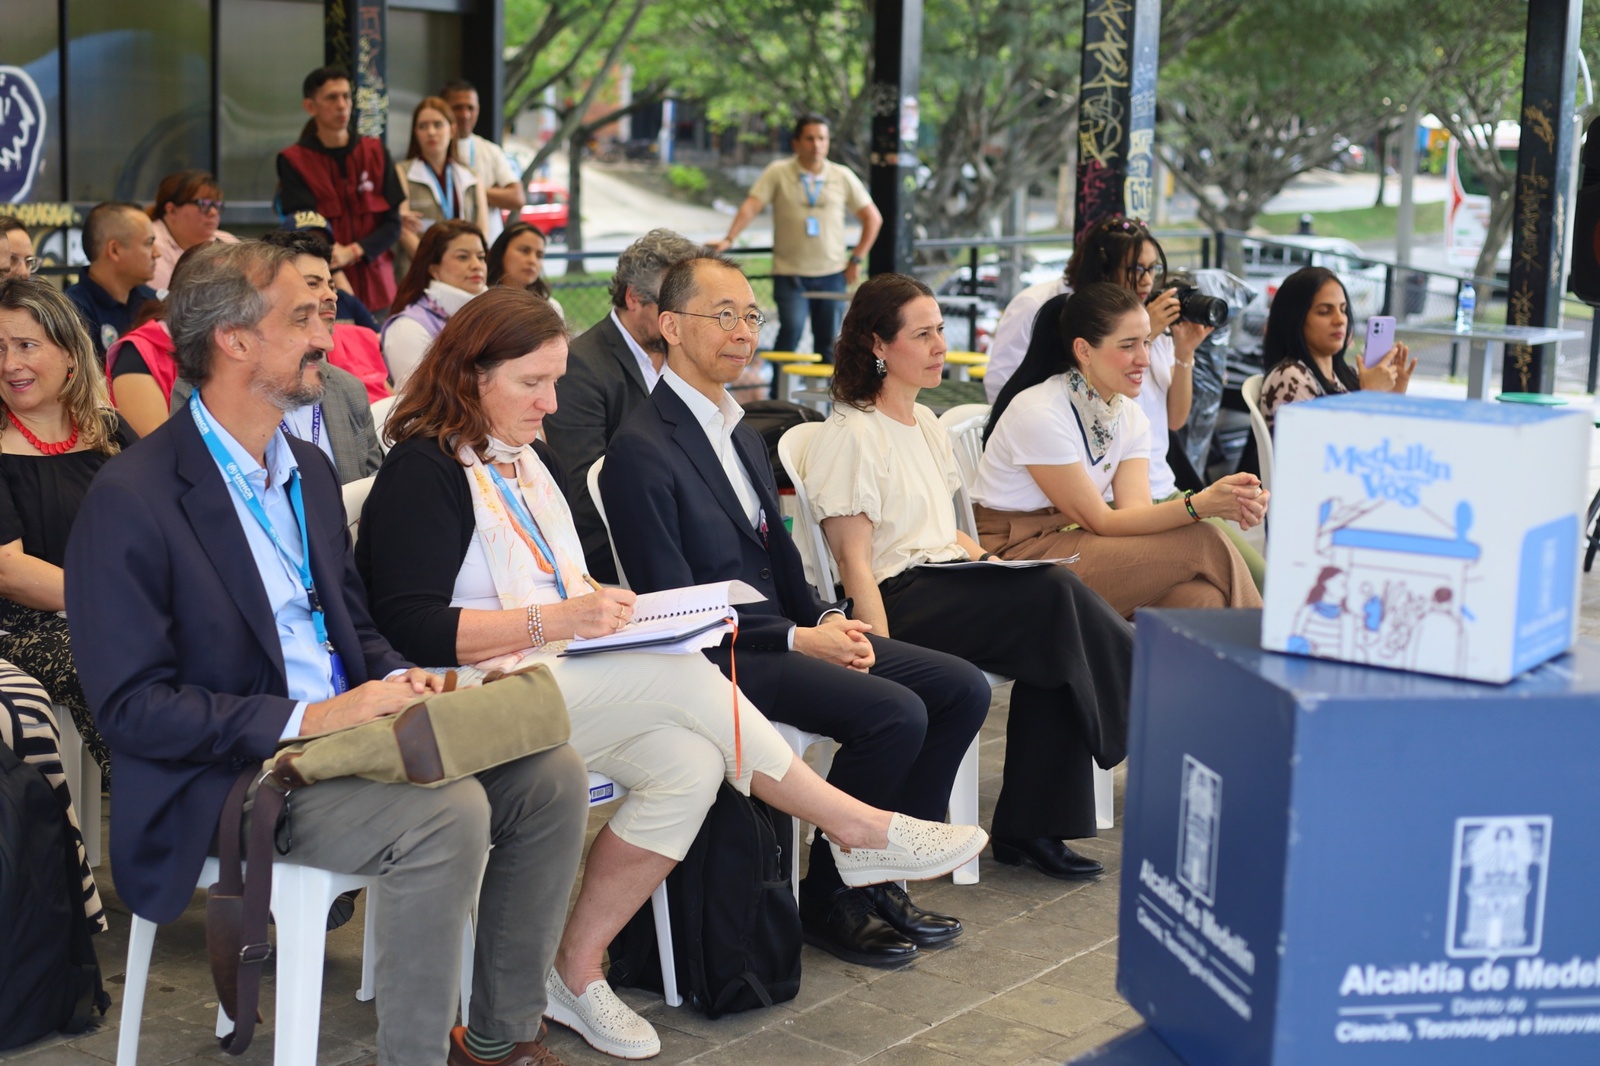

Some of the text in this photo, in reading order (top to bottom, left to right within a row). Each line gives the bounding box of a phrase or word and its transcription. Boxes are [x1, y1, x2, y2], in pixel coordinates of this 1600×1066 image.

[193, 407, 210, 434] UNHCR
[235, 471, 254, 500] UNHCR
[1339, 961, 1465, 996] Alcaldía
[1469, 960, 1510, 991] de
[1518, 1016, 1533, 1036] e
